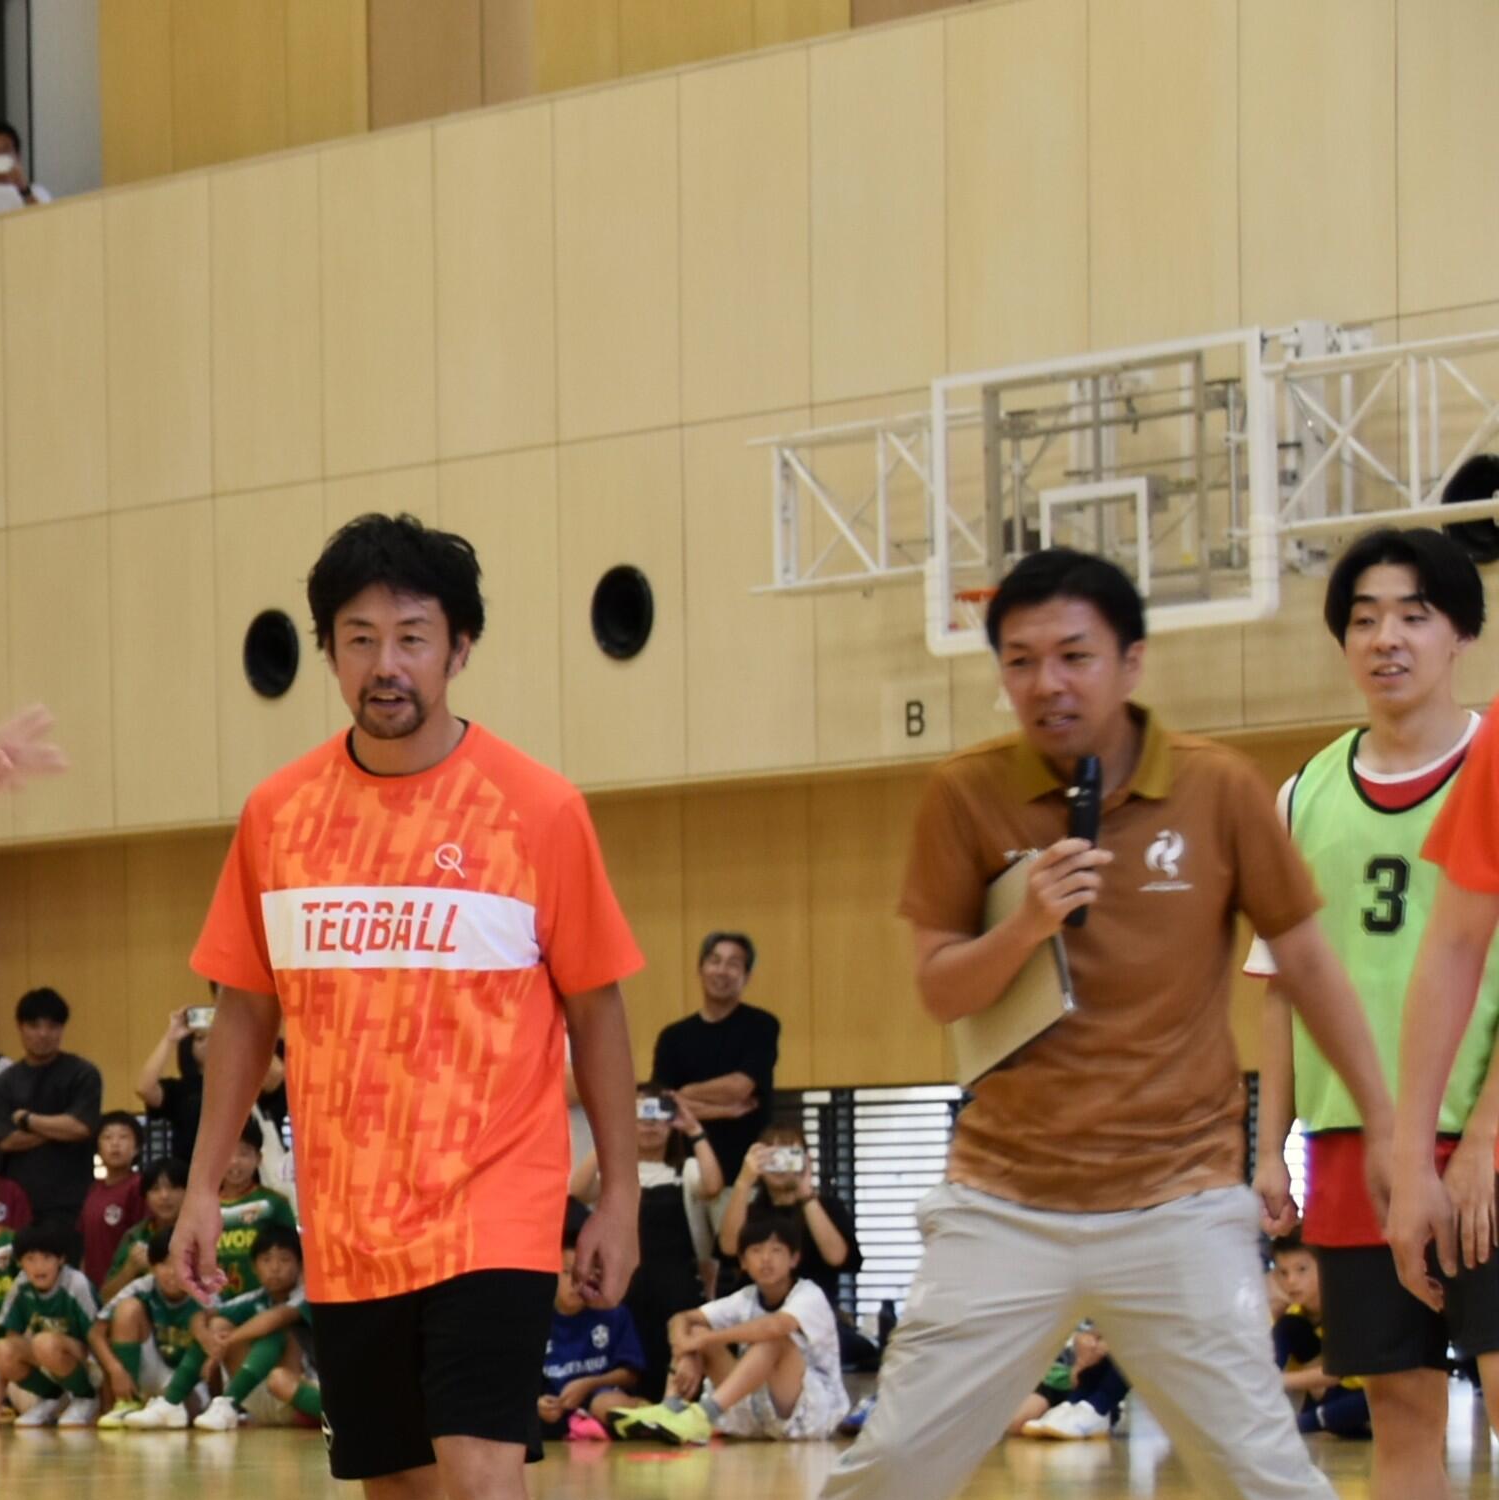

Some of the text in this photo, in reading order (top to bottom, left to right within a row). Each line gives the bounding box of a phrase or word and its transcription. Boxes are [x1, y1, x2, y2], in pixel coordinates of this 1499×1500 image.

[905, 700, 925, 737] B
[1361, 854, 1411, 936] 3
[301, 900, 459, 956] TEQBALL
